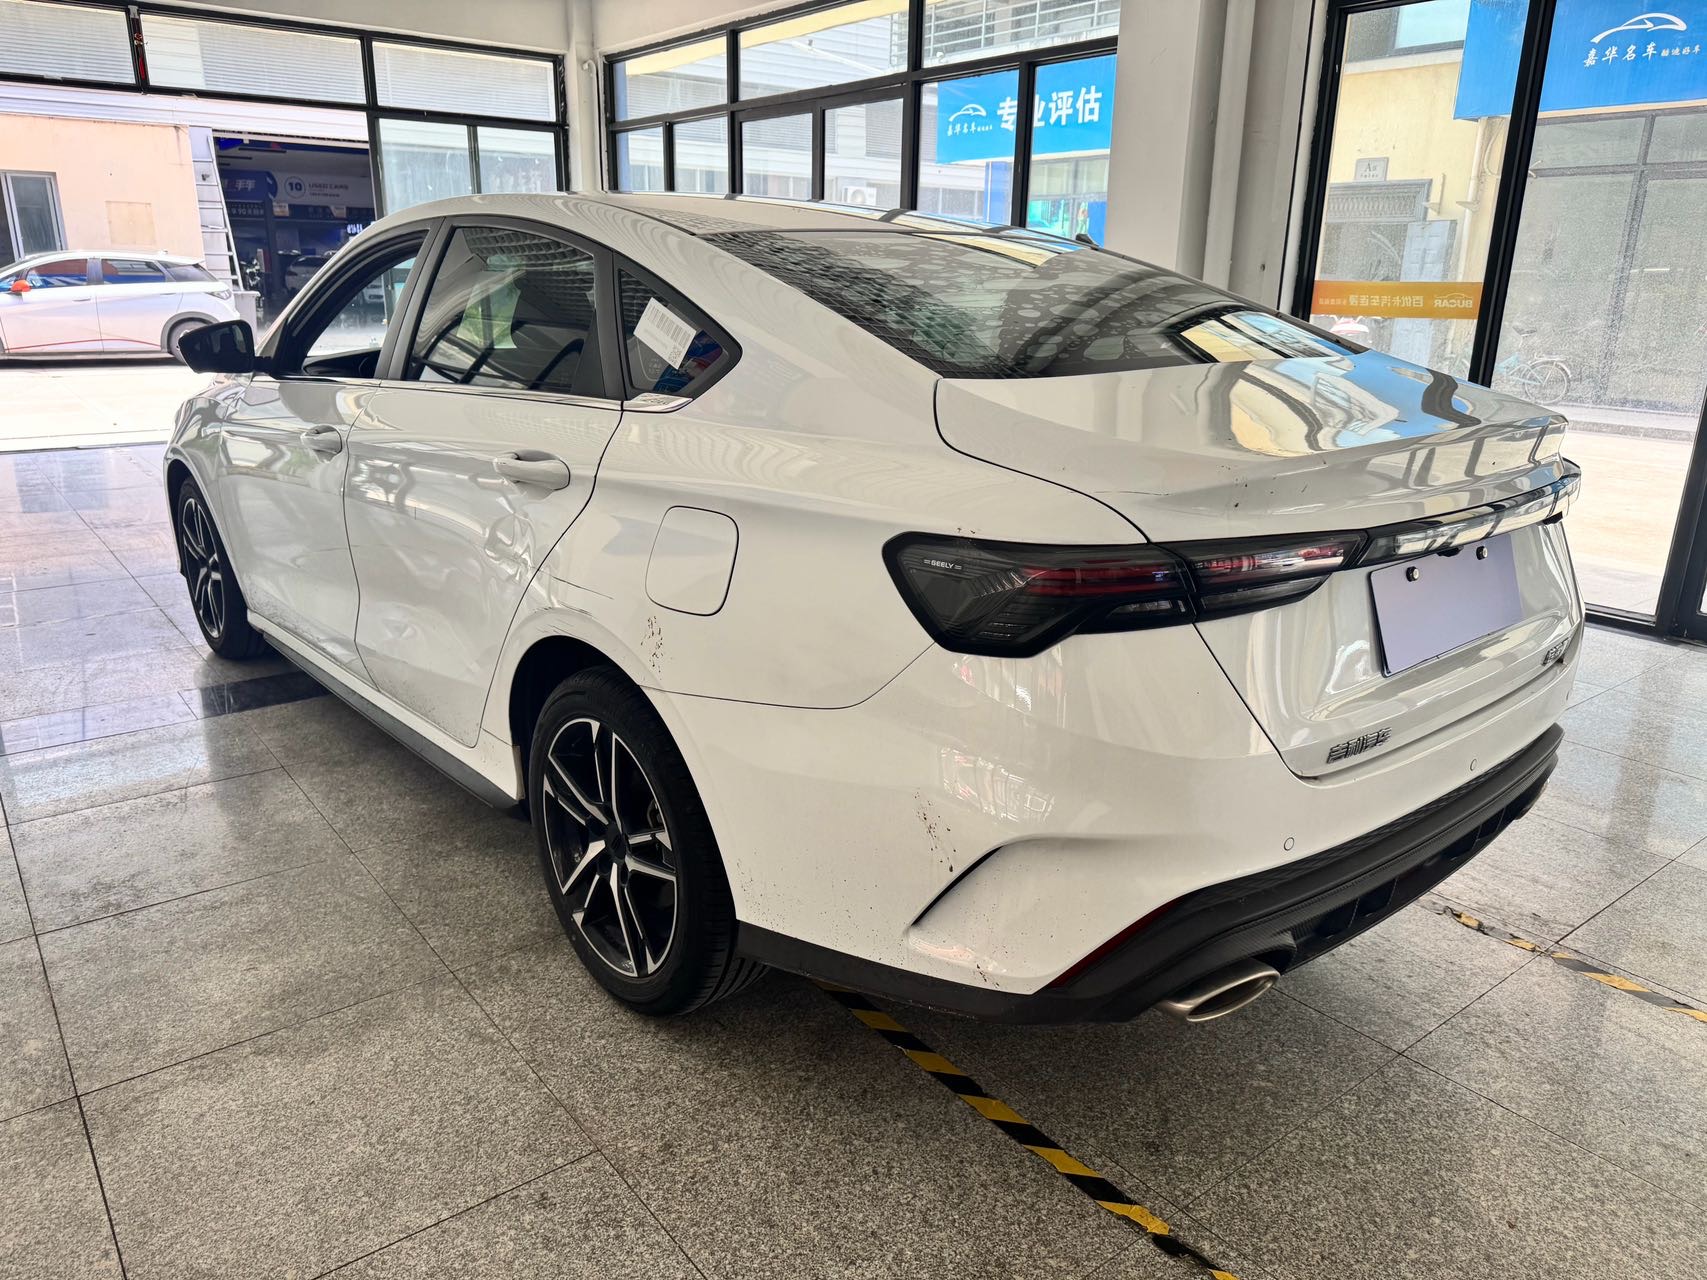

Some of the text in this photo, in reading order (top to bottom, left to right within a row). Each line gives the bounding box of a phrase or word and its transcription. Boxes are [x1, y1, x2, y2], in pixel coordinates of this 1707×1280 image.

[1583, 41, 1657, 68] 嘉华名车
[287, 181, 303, 192] 10
[930, 559, 954, 569] GEELY
[1326, 726, 1393, 765] 吉利汽车
